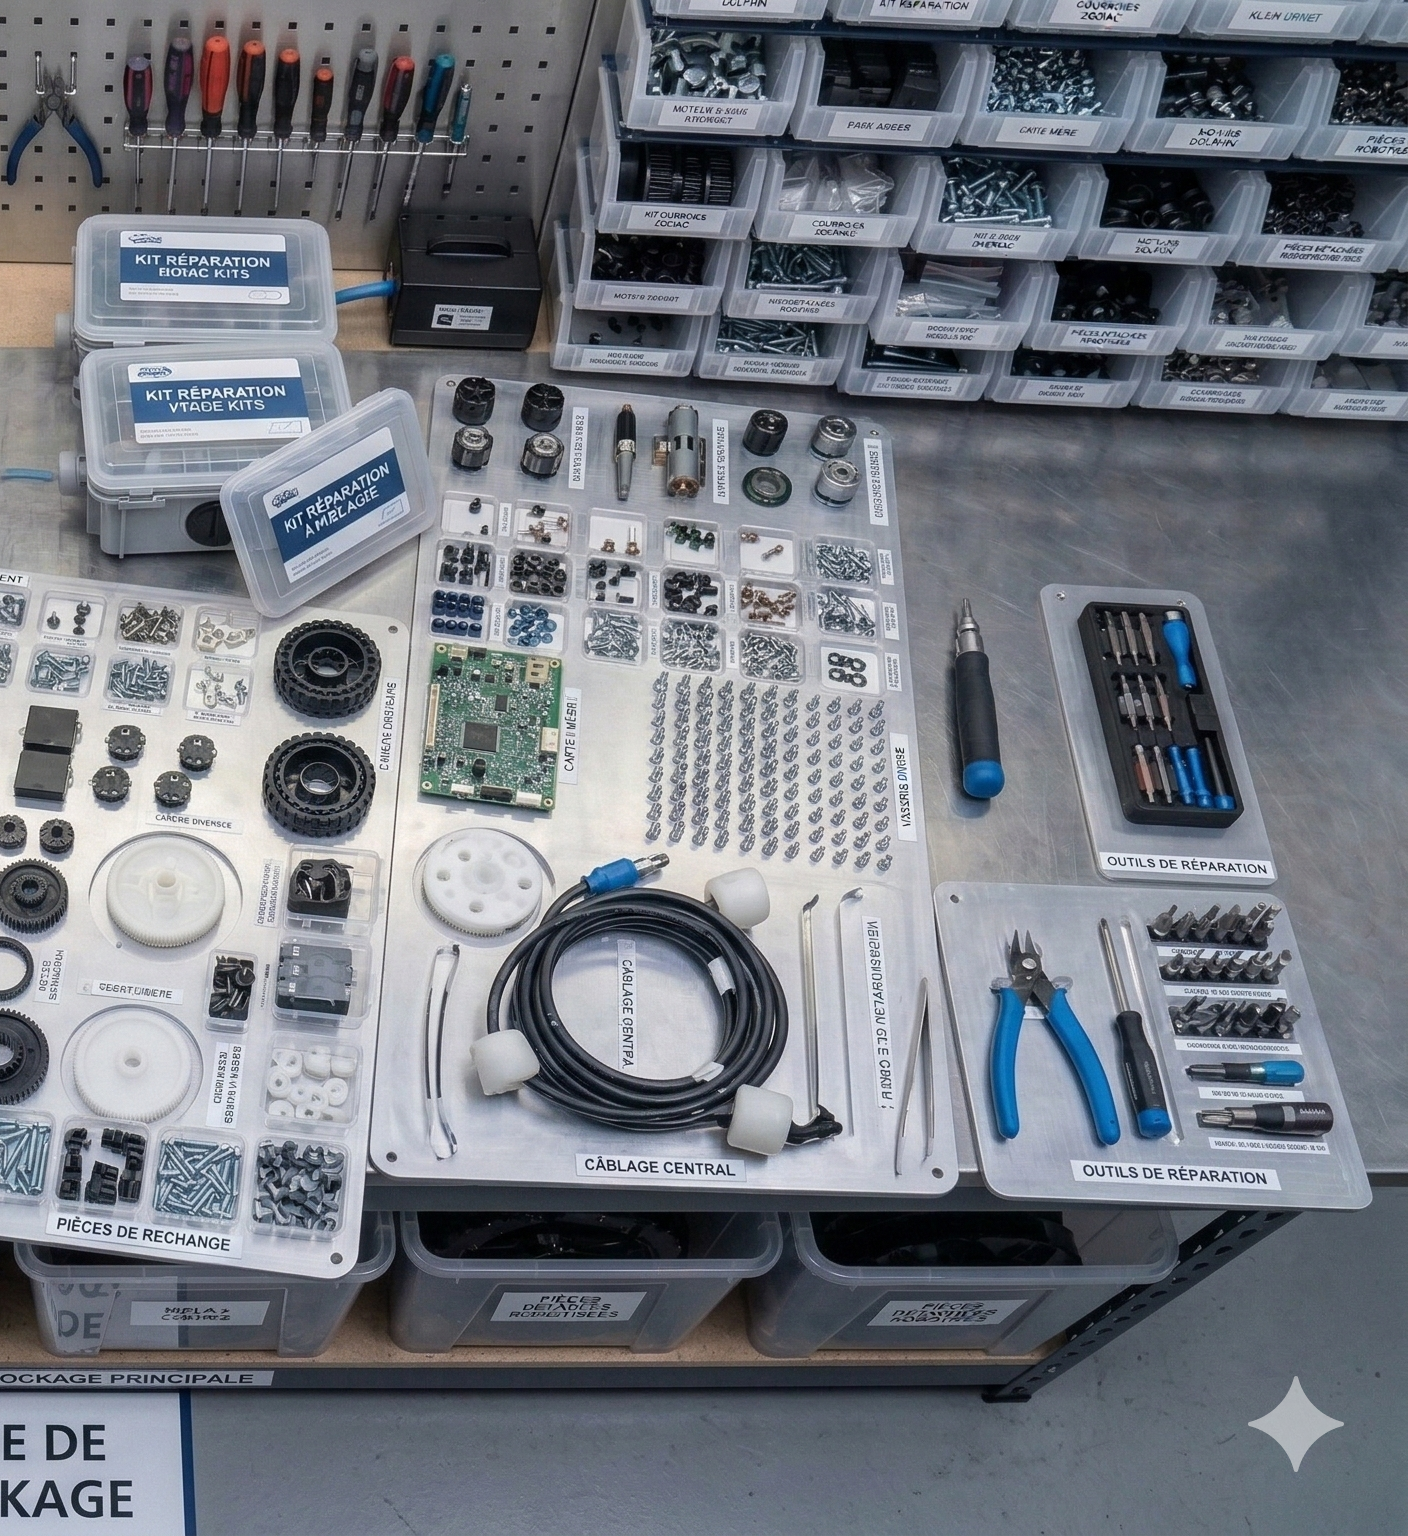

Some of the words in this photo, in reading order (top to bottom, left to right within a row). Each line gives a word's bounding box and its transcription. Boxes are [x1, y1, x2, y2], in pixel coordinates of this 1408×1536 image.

[135, 253, 161, 267] KIT
[166, 251, 271, 269] RÉPARATION
[214, 268, 250, 280] KITS
[145, 388, 175, 402] KIT
[177, 384, 286, 401] RÉPARATION
[227, 399, 265, 412] KITS
[284, 513, 306, 534] KIT
[306, 462, 391, 519] RÉPARATION
[1107, 856, 1156, 869] OUTILS
[1159, 859, 1179, 870] DE
[1181, 858, 1268, 875] RÉPARATION
[584, 1156, 660, 1174] CÂBLAGE
[663, 1161, 736, 1177] CENTRAL
[1082, 1164, 1139, 1180] OUTILS
[1141, 1167, 1165, 1180] DE
[1167, 1165, 1268, 1185] RÉPARATION
[57, 1216, 113, 1236] PIÈCES
[116, 1225, 139, 1240] DE
[142, 1228, 231, 1252] RECHANGE
[110, 1373, 254, 1385] PRINCIPALE
[45, 1424, 106, 1461] DE
